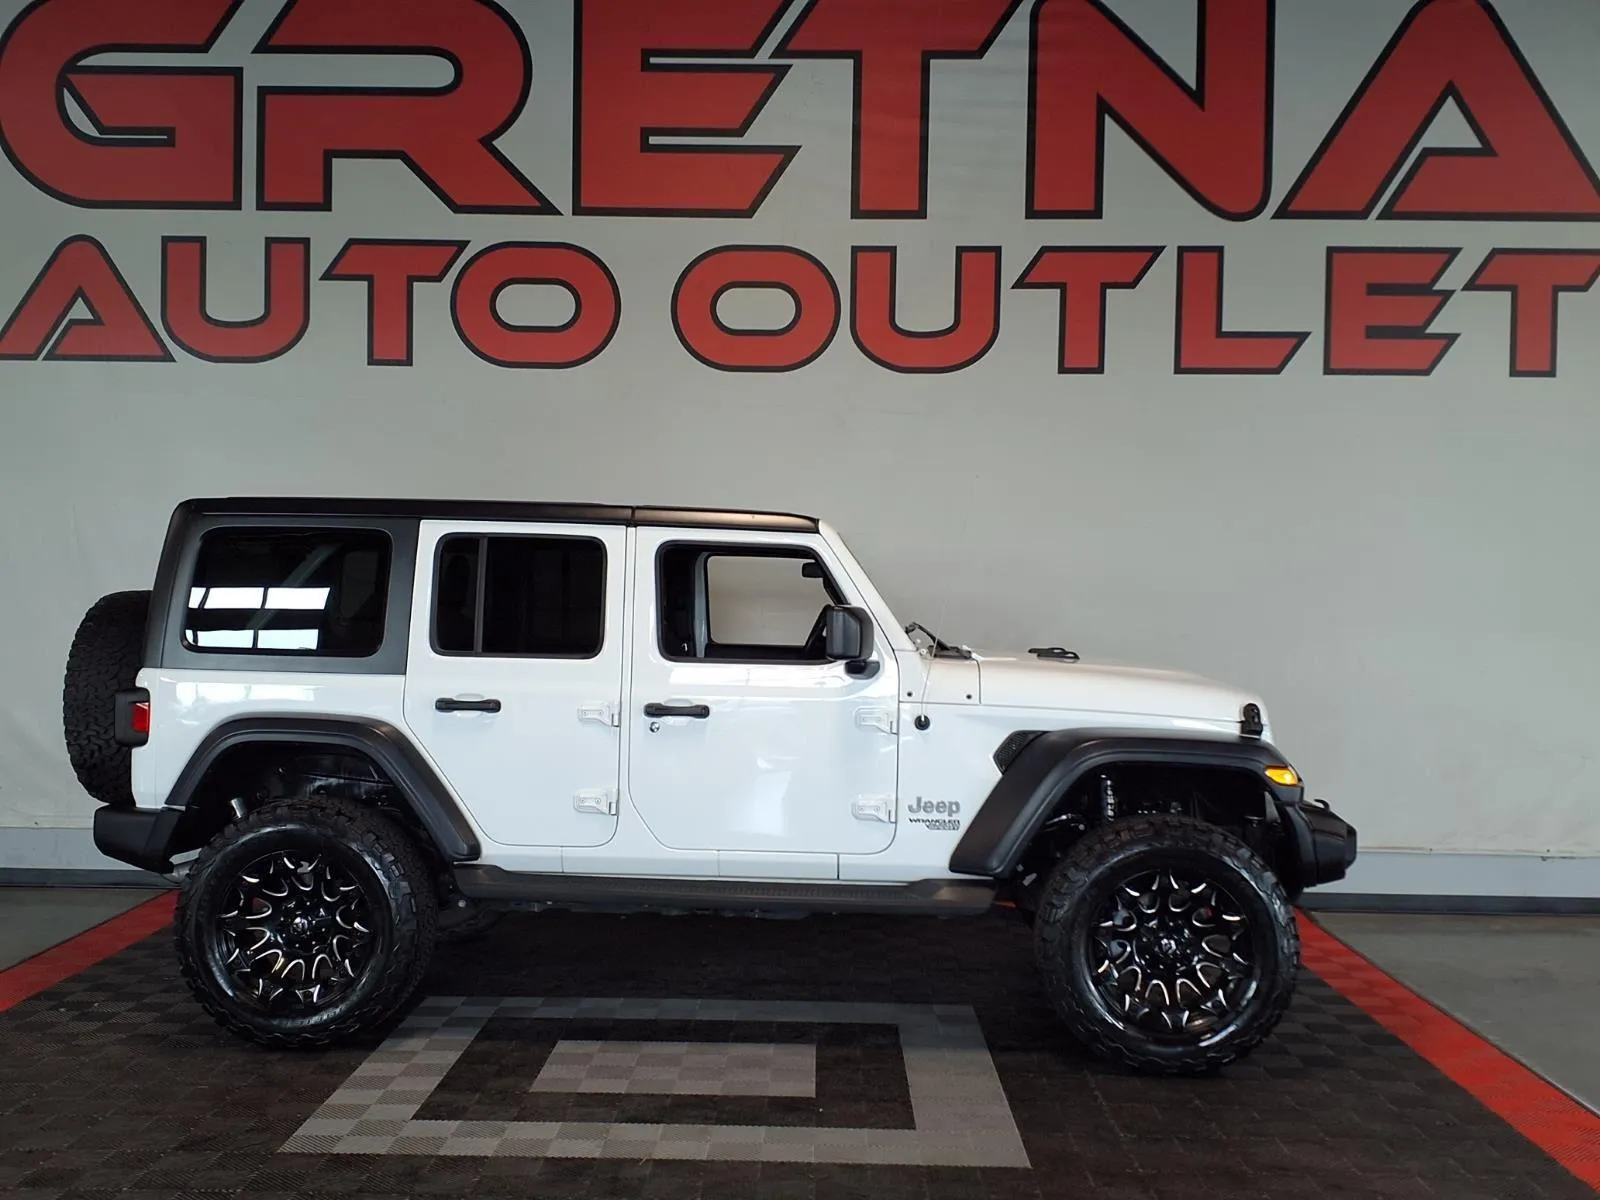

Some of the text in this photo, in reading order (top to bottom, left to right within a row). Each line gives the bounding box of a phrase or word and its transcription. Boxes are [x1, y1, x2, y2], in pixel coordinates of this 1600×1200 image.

[0, 0, 1600, 221] GRETNA
[0, 234, 1600, 378] AUTO OUTLET
[908, 796, 961, 817] Jeep
